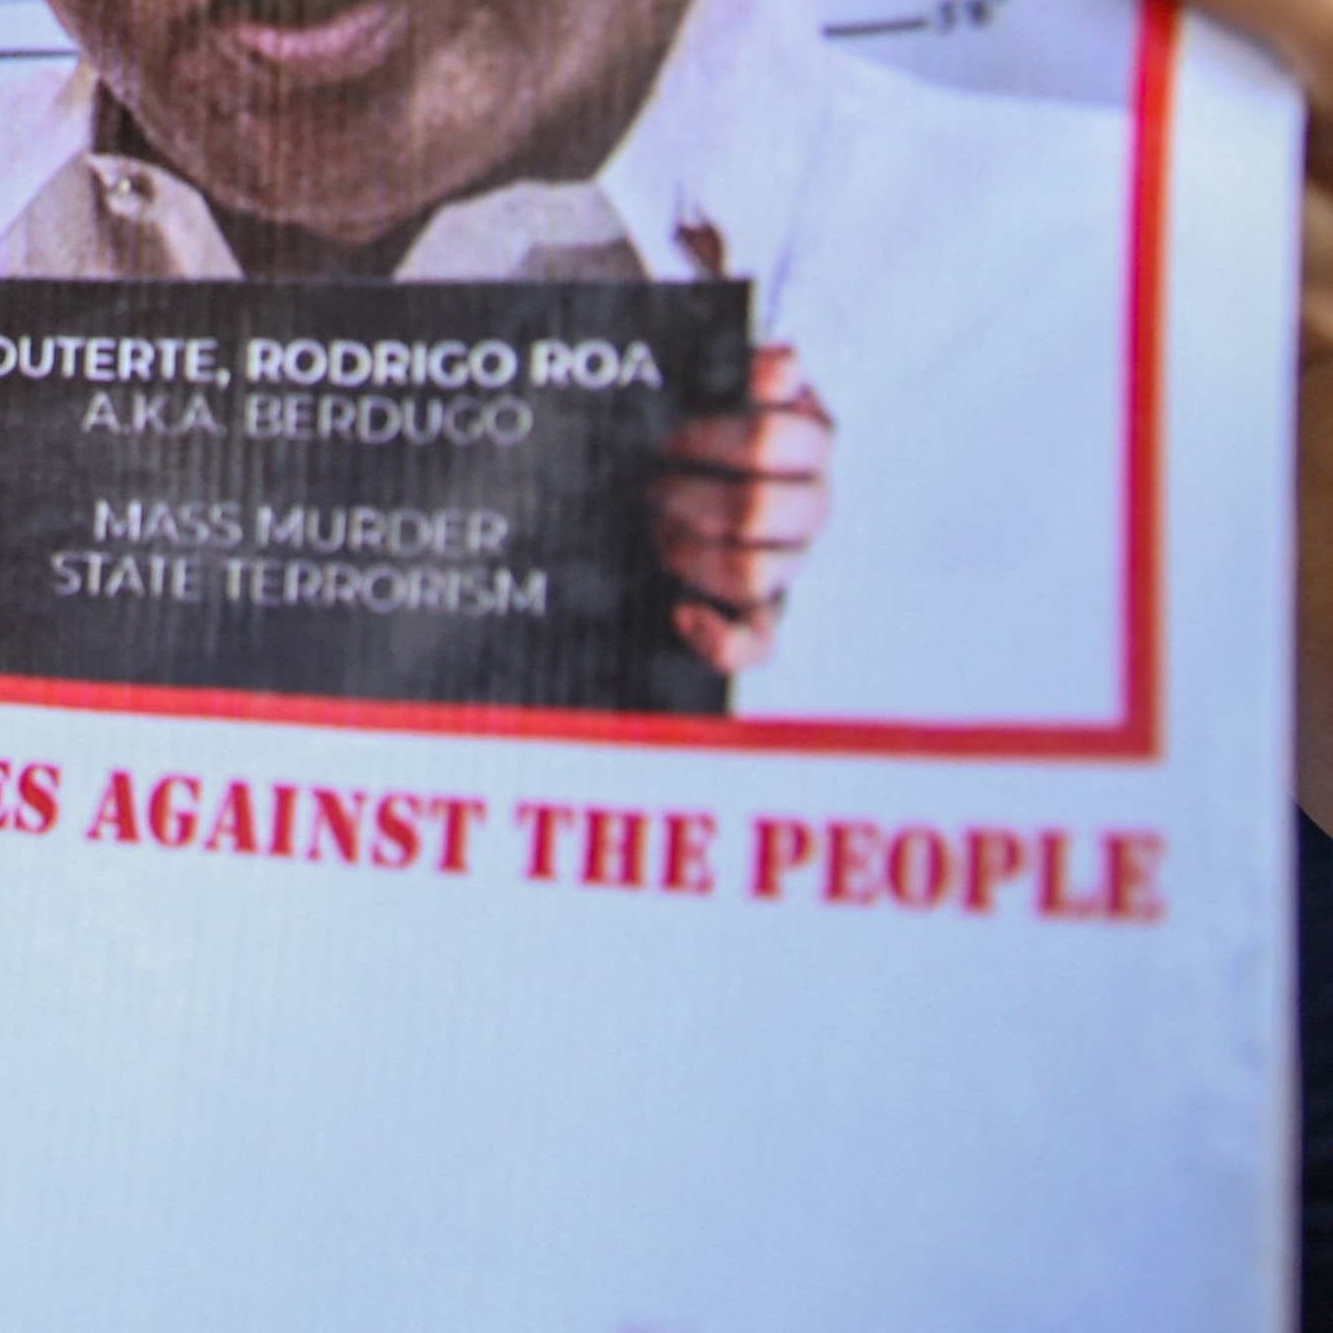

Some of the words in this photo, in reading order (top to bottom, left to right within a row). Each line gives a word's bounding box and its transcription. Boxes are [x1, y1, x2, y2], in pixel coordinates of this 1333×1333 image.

[246, 338, 518, 387] RODRIGO
[532, 341, 661, 387] ROA
[246, 396, 532, 444] BERDUGO
[93, 499, 242, 544] MASS
[258, 507, 507, 553] MURDER
[51, 551, 199, 599] STATE
[227, 559, 545, 609] TERRORISM
[86, 769, 485, 873] AGAINST
[516, 802, 714, 894] THE
[749, 816, 1157, 918] PEOPLE
